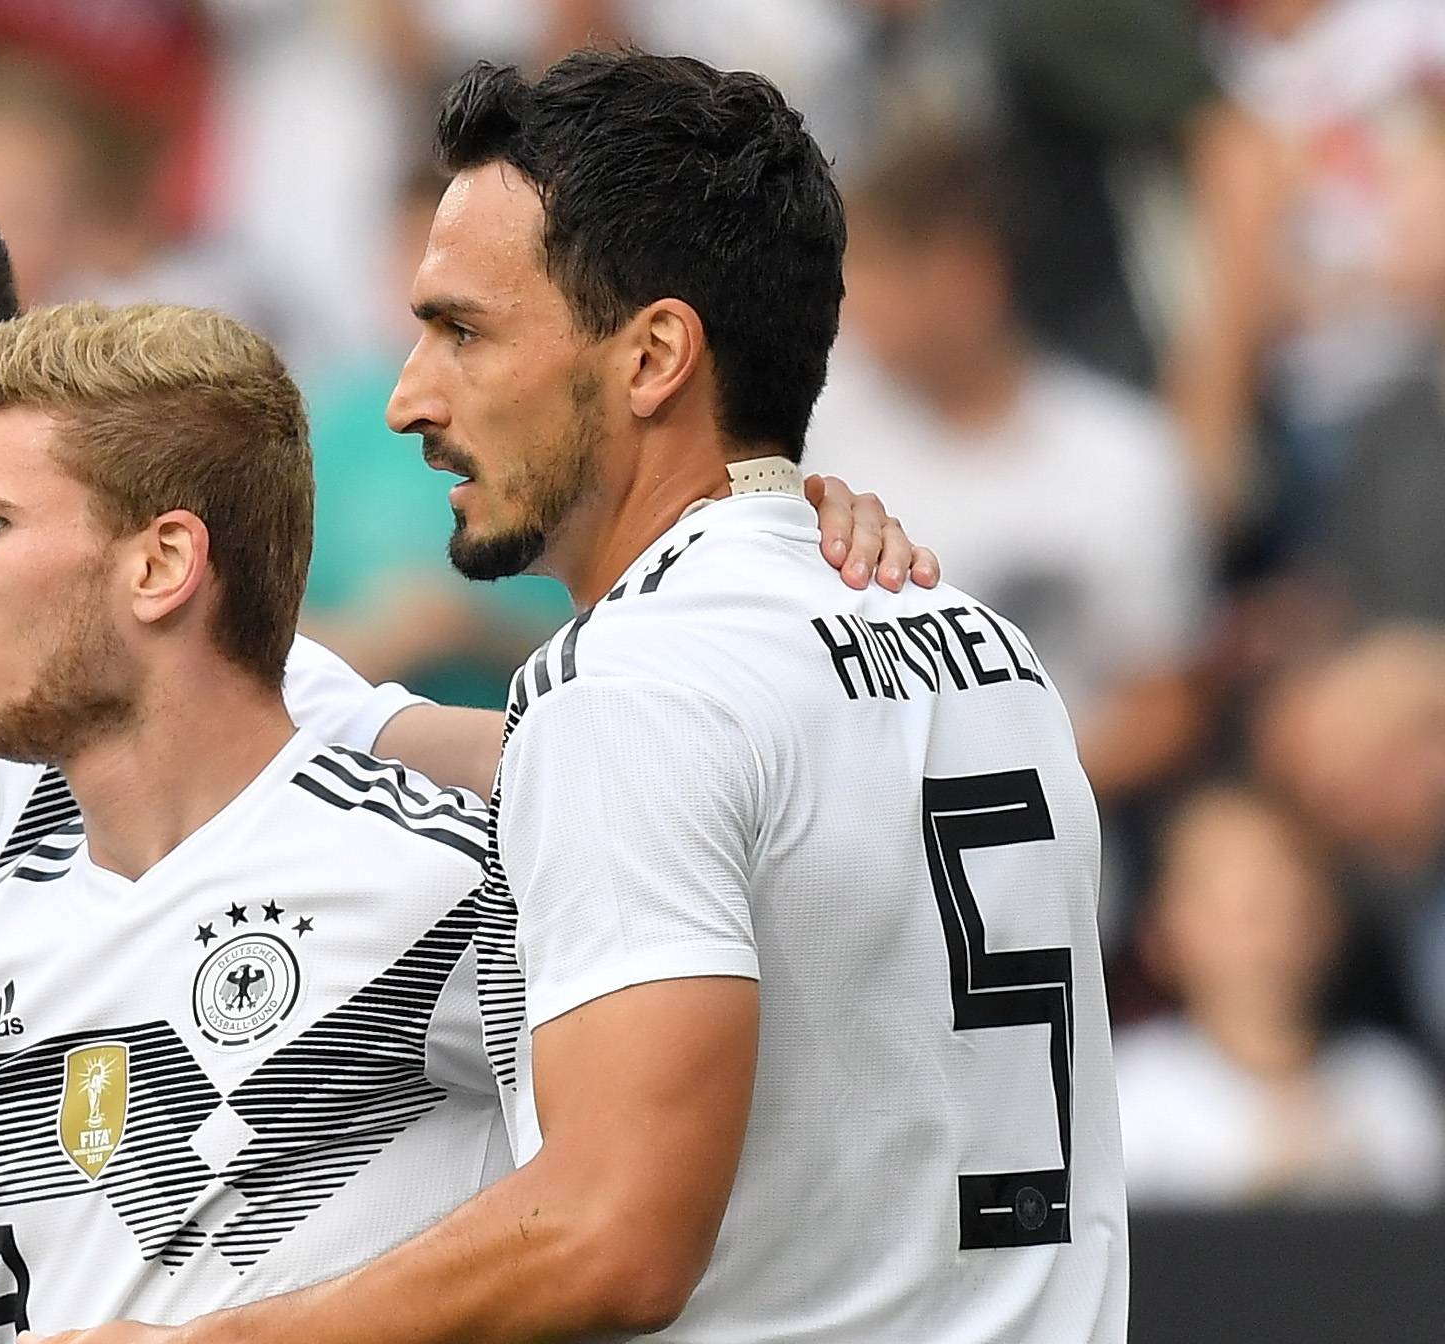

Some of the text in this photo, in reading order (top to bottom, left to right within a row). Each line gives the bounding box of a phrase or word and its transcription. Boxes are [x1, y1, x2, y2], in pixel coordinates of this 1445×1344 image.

[810, 606, 1048, 701] HUMMEL
[217, 945, 278, 970] DEUTSCHER
[206, 999, 278, 1031] FUSSBALL-BUND
[921, 768, 1075, 1250] 5
[80, 1129, 110, 1148] FIFA
